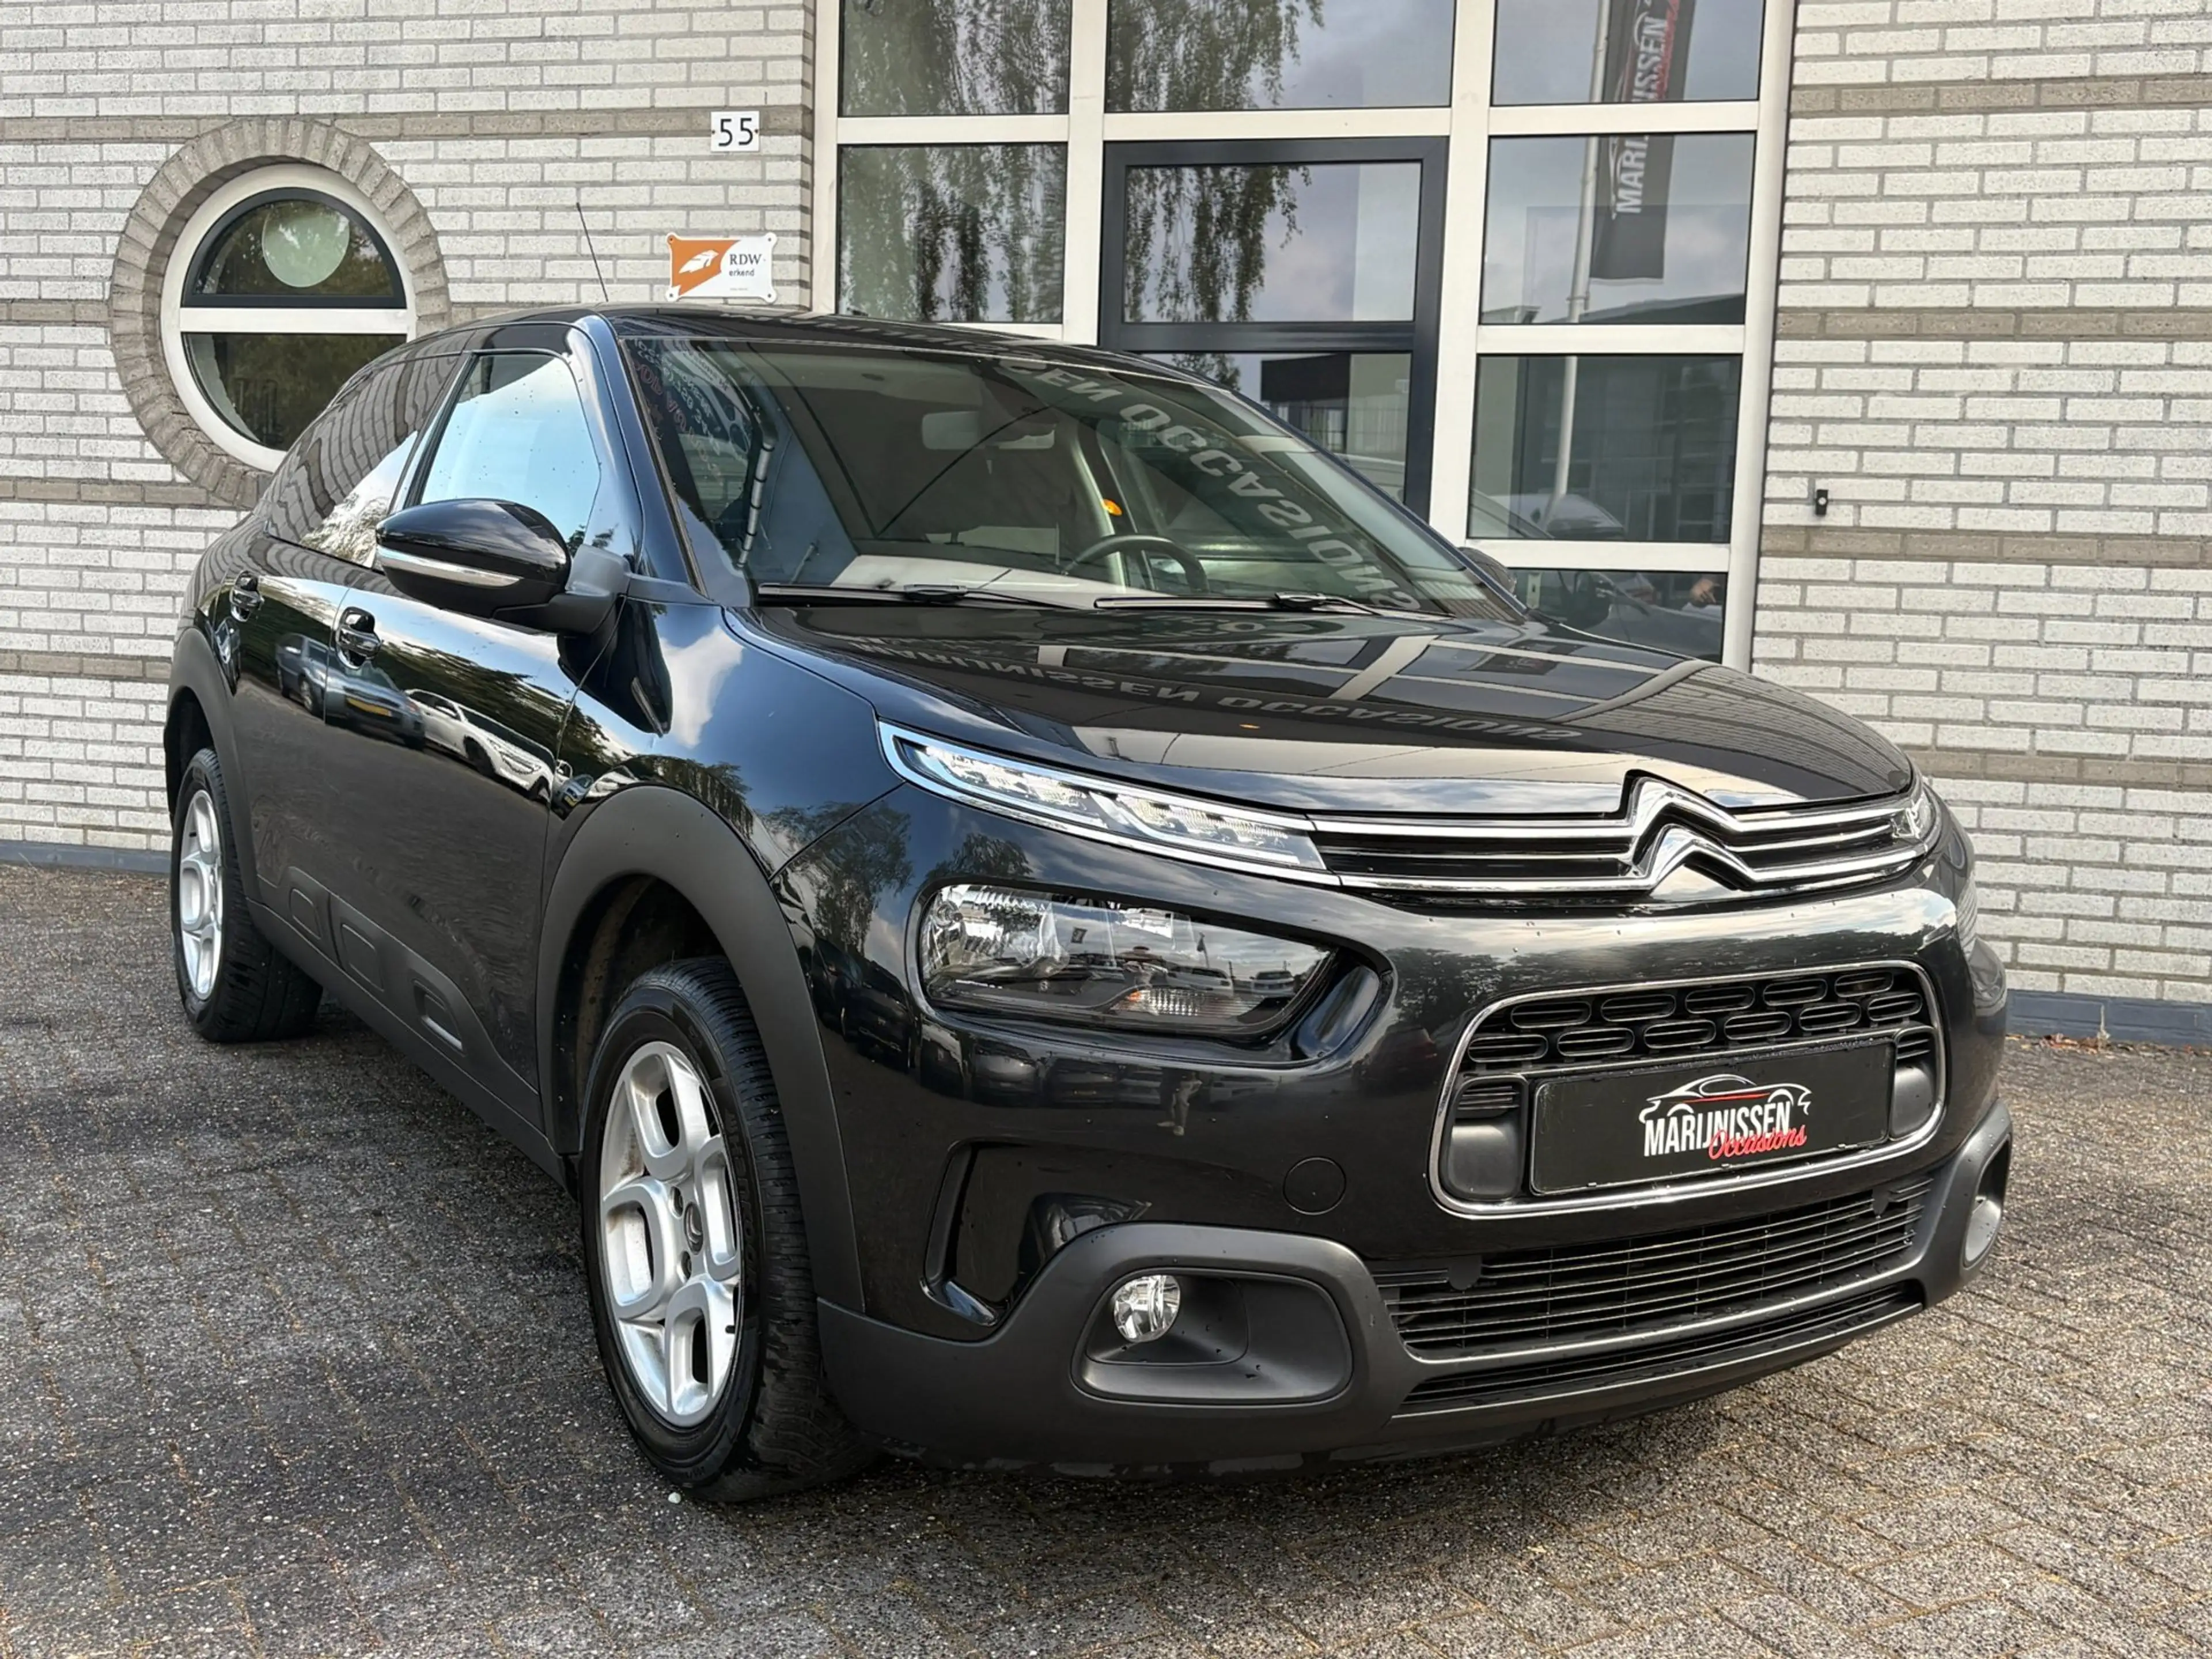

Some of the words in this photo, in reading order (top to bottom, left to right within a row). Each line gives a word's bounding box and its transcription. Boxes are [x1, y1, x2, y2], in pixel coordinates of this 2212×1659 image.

[718, 118, 753, 147] 55
[729, 253, 763, 266] RDW
[729, 268, 755, 276] erkend
[1643, 1101, 1791, 1157] MARIJNISSEN
[1709, 1124, 1808, 1160] Occasions
